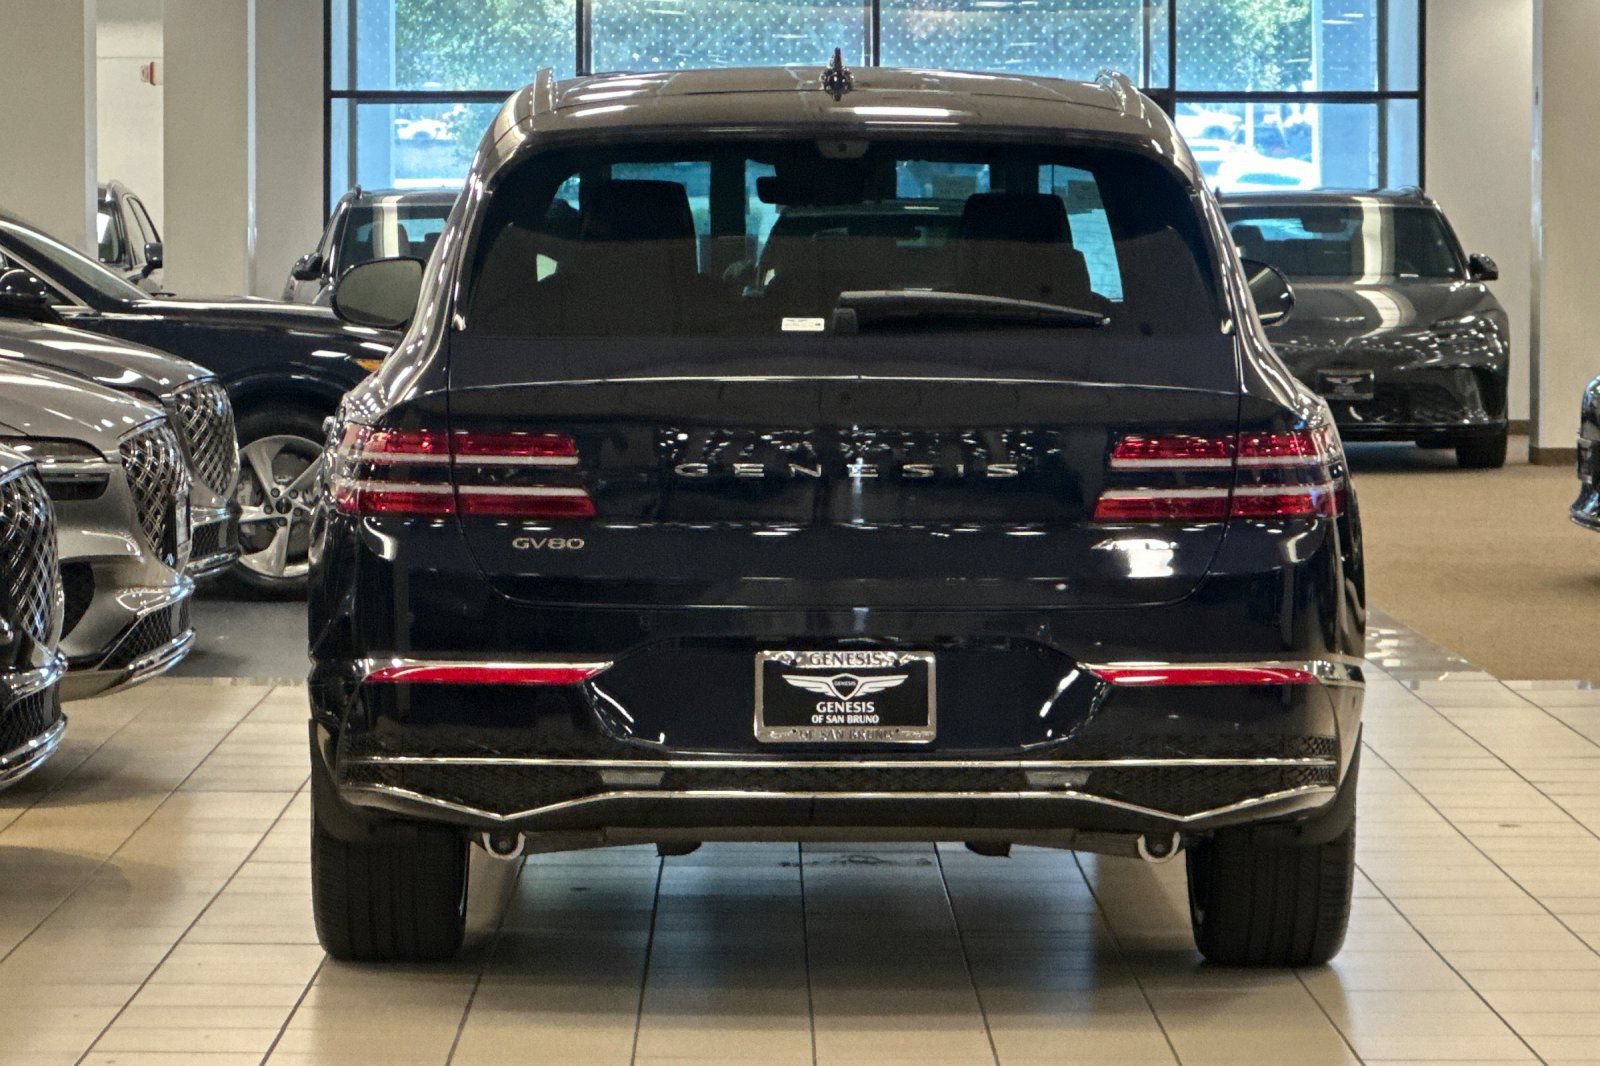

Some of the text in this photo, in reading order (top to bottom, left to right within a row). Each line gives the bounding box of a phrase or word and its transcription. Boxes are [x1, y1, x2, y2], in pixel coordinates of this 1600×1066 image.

[674, 462, 1019, 478] GENESIS
[511, 537, 585, 549] GV80
[809, 652, 882, 666] GENESIS
[816, 701, 875, 713] GENESIS
[811, 714, 879, 724] OF SAN BRUNO
